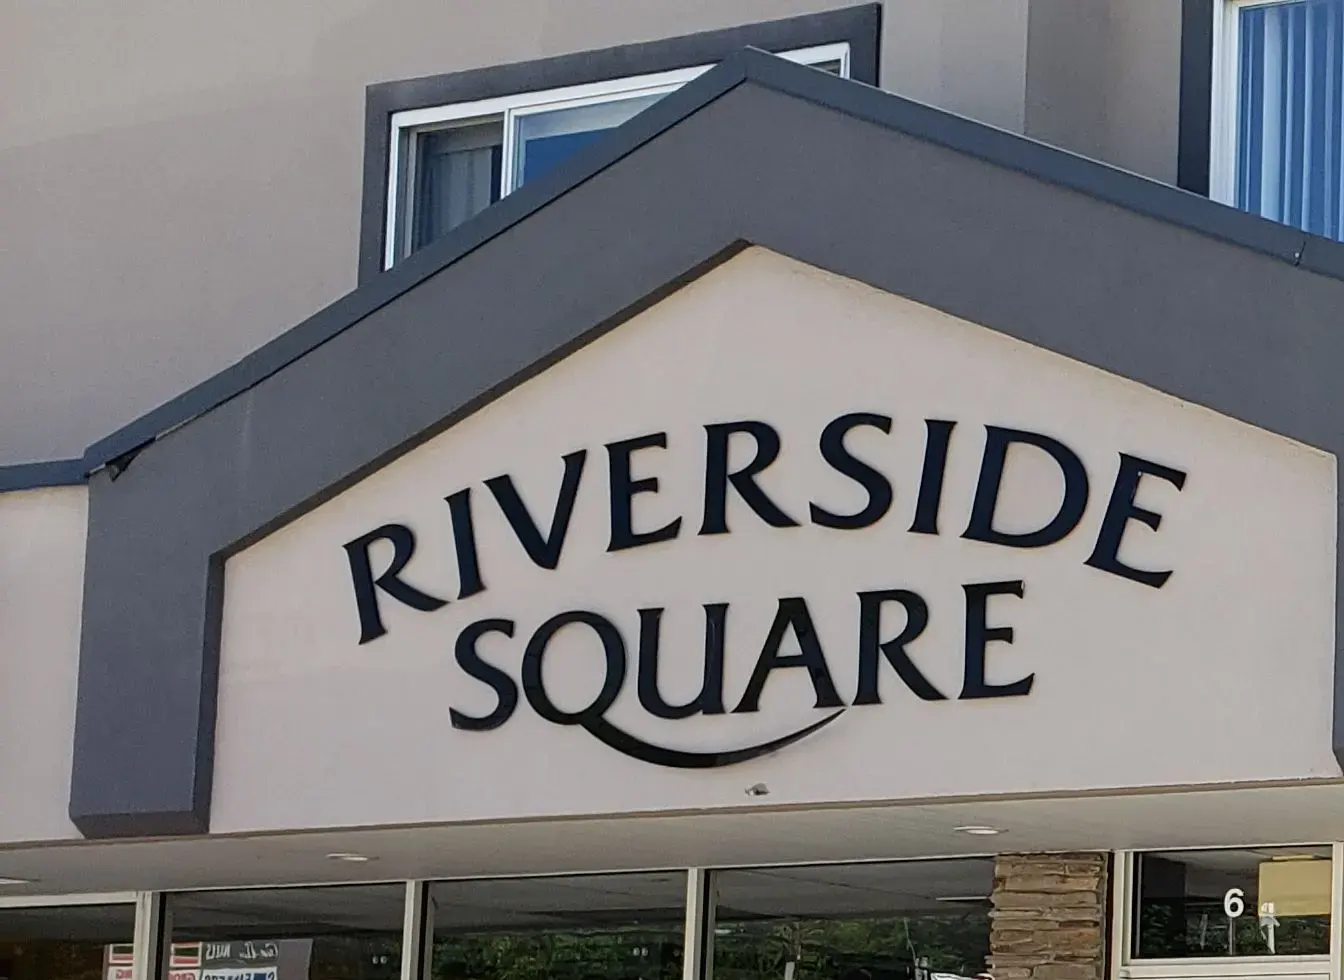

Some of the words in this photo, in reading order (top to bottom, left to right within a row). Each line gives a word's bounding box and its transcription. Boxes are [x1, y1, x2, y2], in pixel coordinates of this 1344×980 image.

[342, 411, 1188, 646] RIVERSIDE
[449, 580, 1036, 768] SQUARE
[1224, 888, 1245, 918] 6
